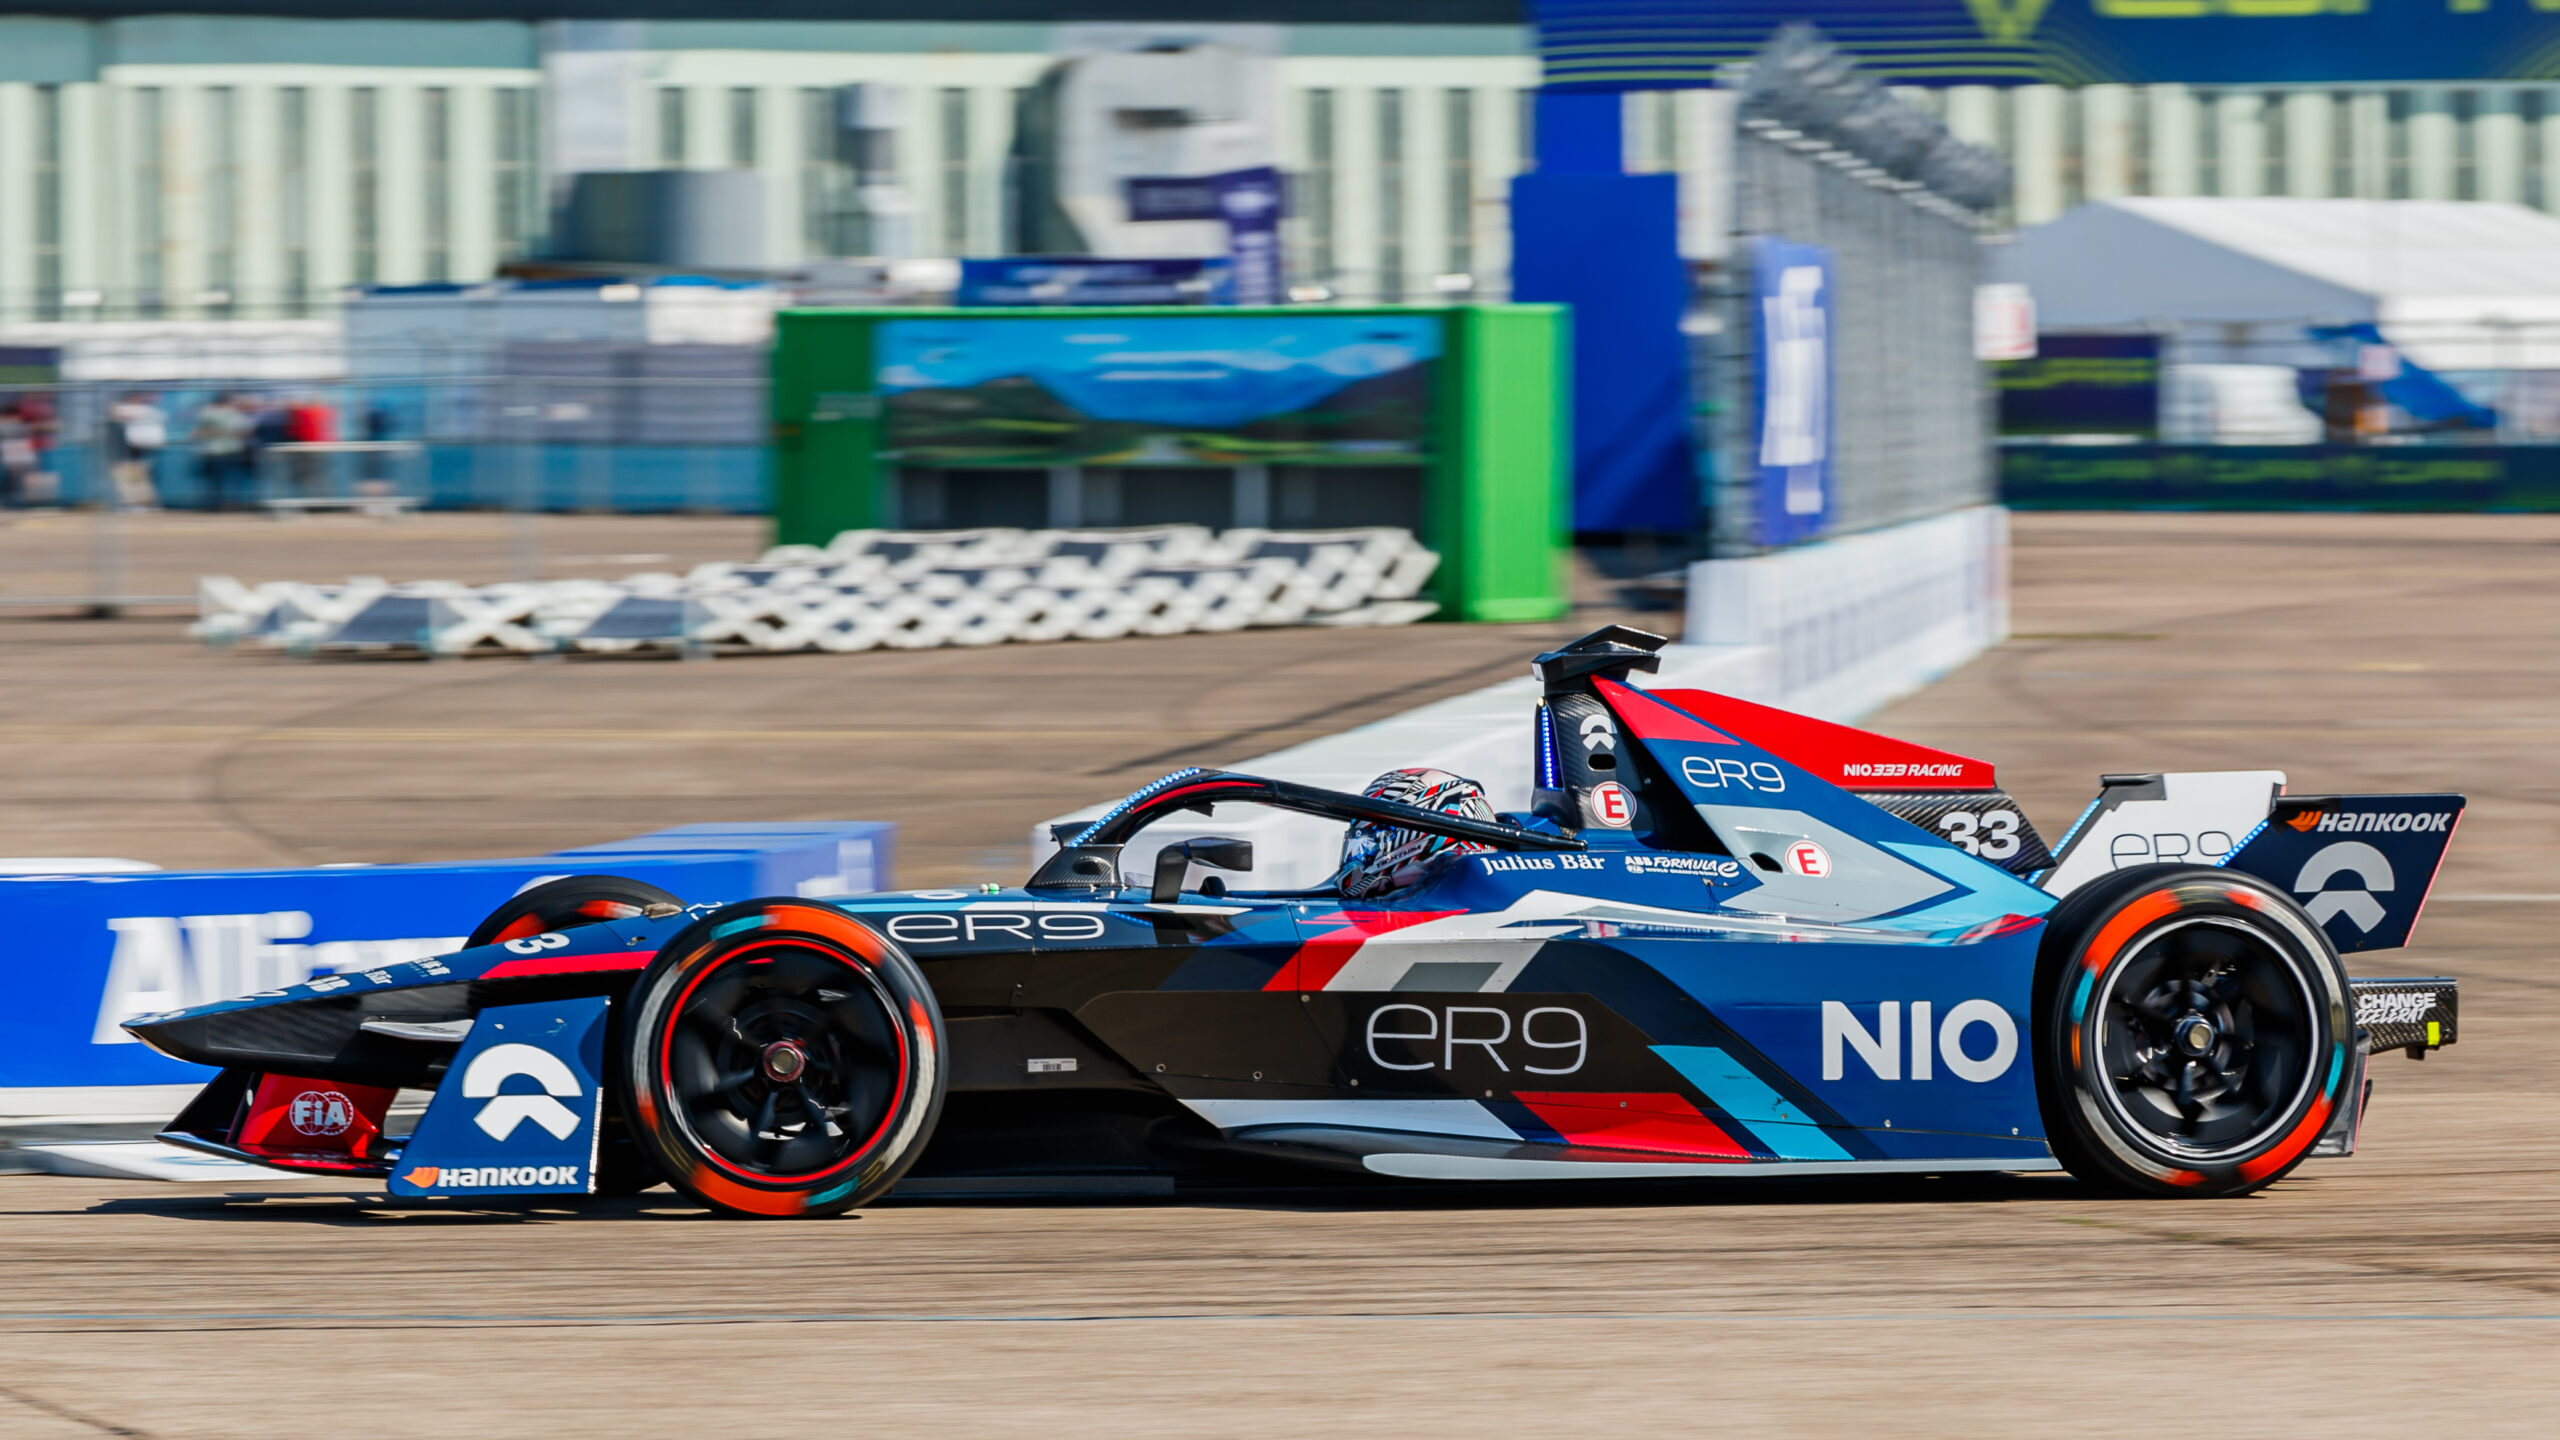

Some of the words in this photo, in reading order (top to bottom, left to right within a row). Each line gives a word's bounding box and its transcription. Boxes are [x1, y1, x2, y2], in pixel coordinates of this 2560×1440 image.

[1908, 763, 1964, 777] RACING
[1601, 789, 1626, 819] E
[2316, 812, 2452, 833] HANKOOK
[1939, 808, 2021, 860] 33
[1479, 853, 1556, 876] Julius
[1557, 853, 1606, 870] Bär
[1624, 855, 1653, 866] ABB
[1653, 856, 1718, 871] FORMULA
[1795, 847, 1822, 875] E
[2358, 992, 2437, 1009] CHANGE
[1821, 998, 2019, 1083] NIO
[436, 1166, 579, 1188] HANKOOK
